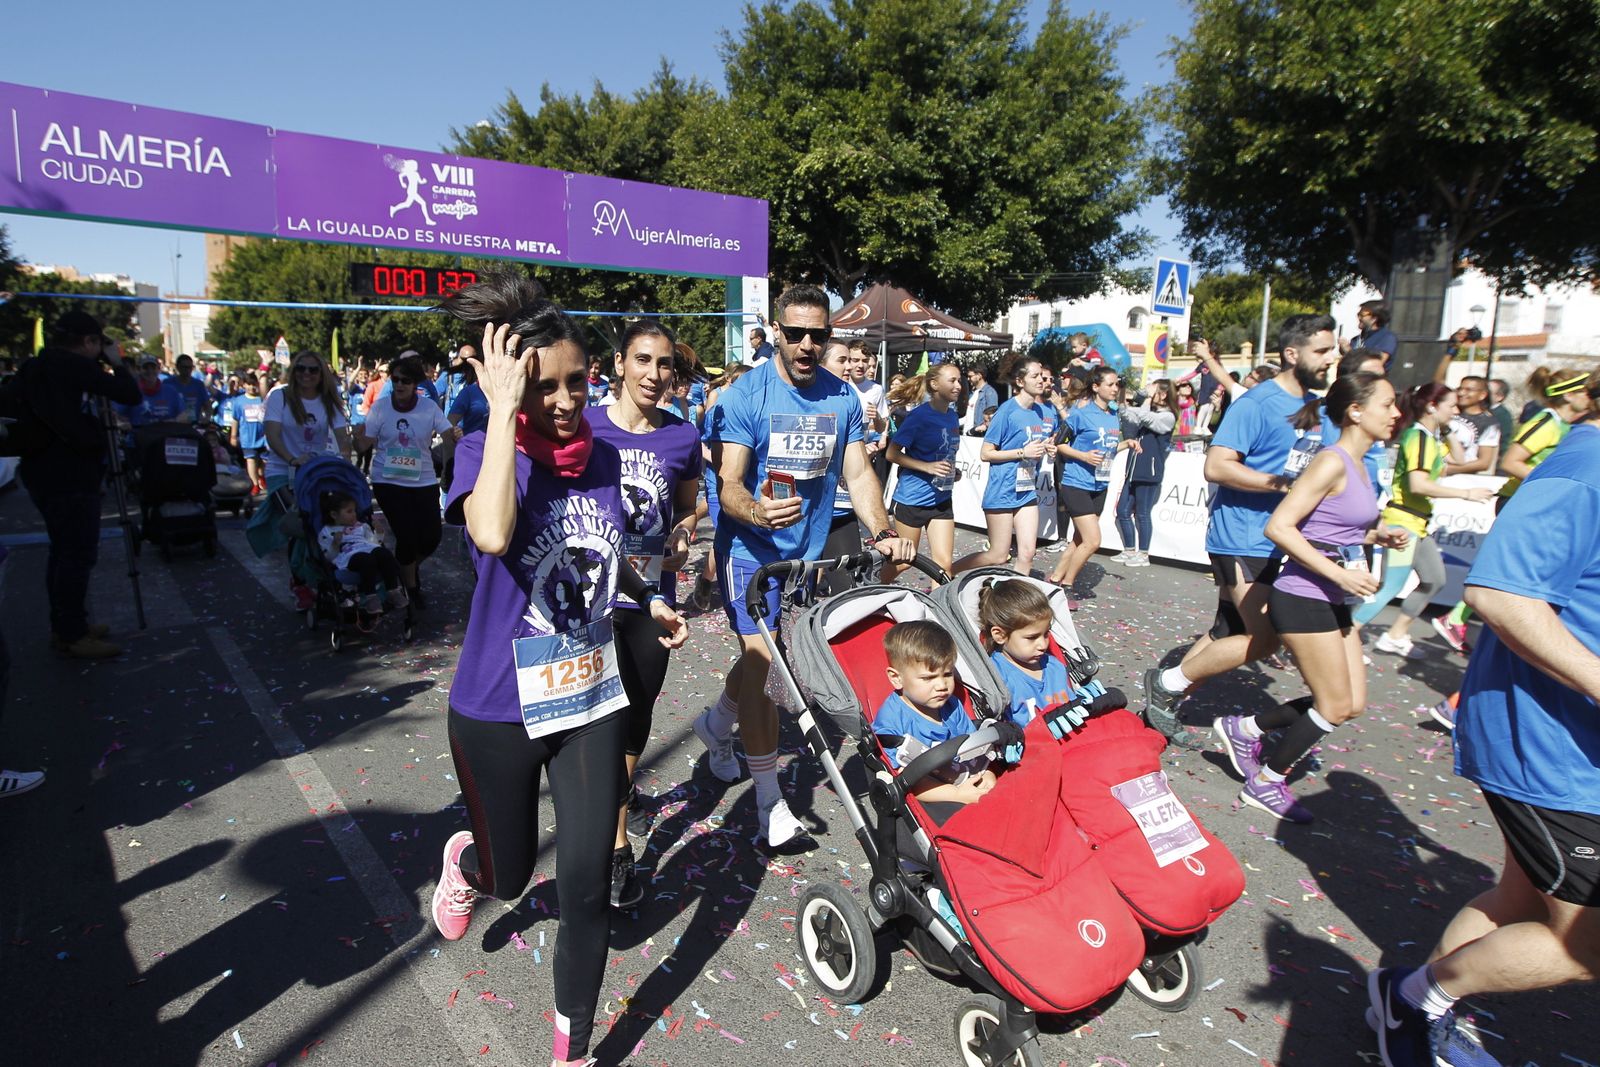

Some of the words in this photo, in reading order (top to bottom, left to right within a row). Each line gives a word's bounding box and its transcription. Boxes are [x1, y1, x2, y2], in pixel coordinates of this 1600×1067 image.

[40, 122, 232, 177] ALMERÍA
[40, 158, 144, 189] CIUDAD
[431, 162, 474, 187] VIII
[432, 185, 476, 198] CARRERA
[432, 199, 478, 221] mujer
[287, 216, 311, 232] LA
[316, 218, 410, 241] IGUALDAD
[415, 230, 434, 244] ES
[440, 231, 512, 250] NUESTRA
[516, 238, 562, 255] META.
[782, 434, 827, 451] 1255
[391, 456, 416, 467] 2324
[619, 449, 656, 465] UNTAS
[547, 495, 598, 521] JUNTAS
[1159, 508, 1207, 527] CIUDA
[1434, 512, 1487, 531] CIÓN
[520, 515, 580, 566] HACEMOS
[572, 627, 587, 638] VIII
[539, 648, 604, 689] 1256
[543, 684, 575, 697] GEMMA
[1138, 801, 1184, 829] ATLETA
